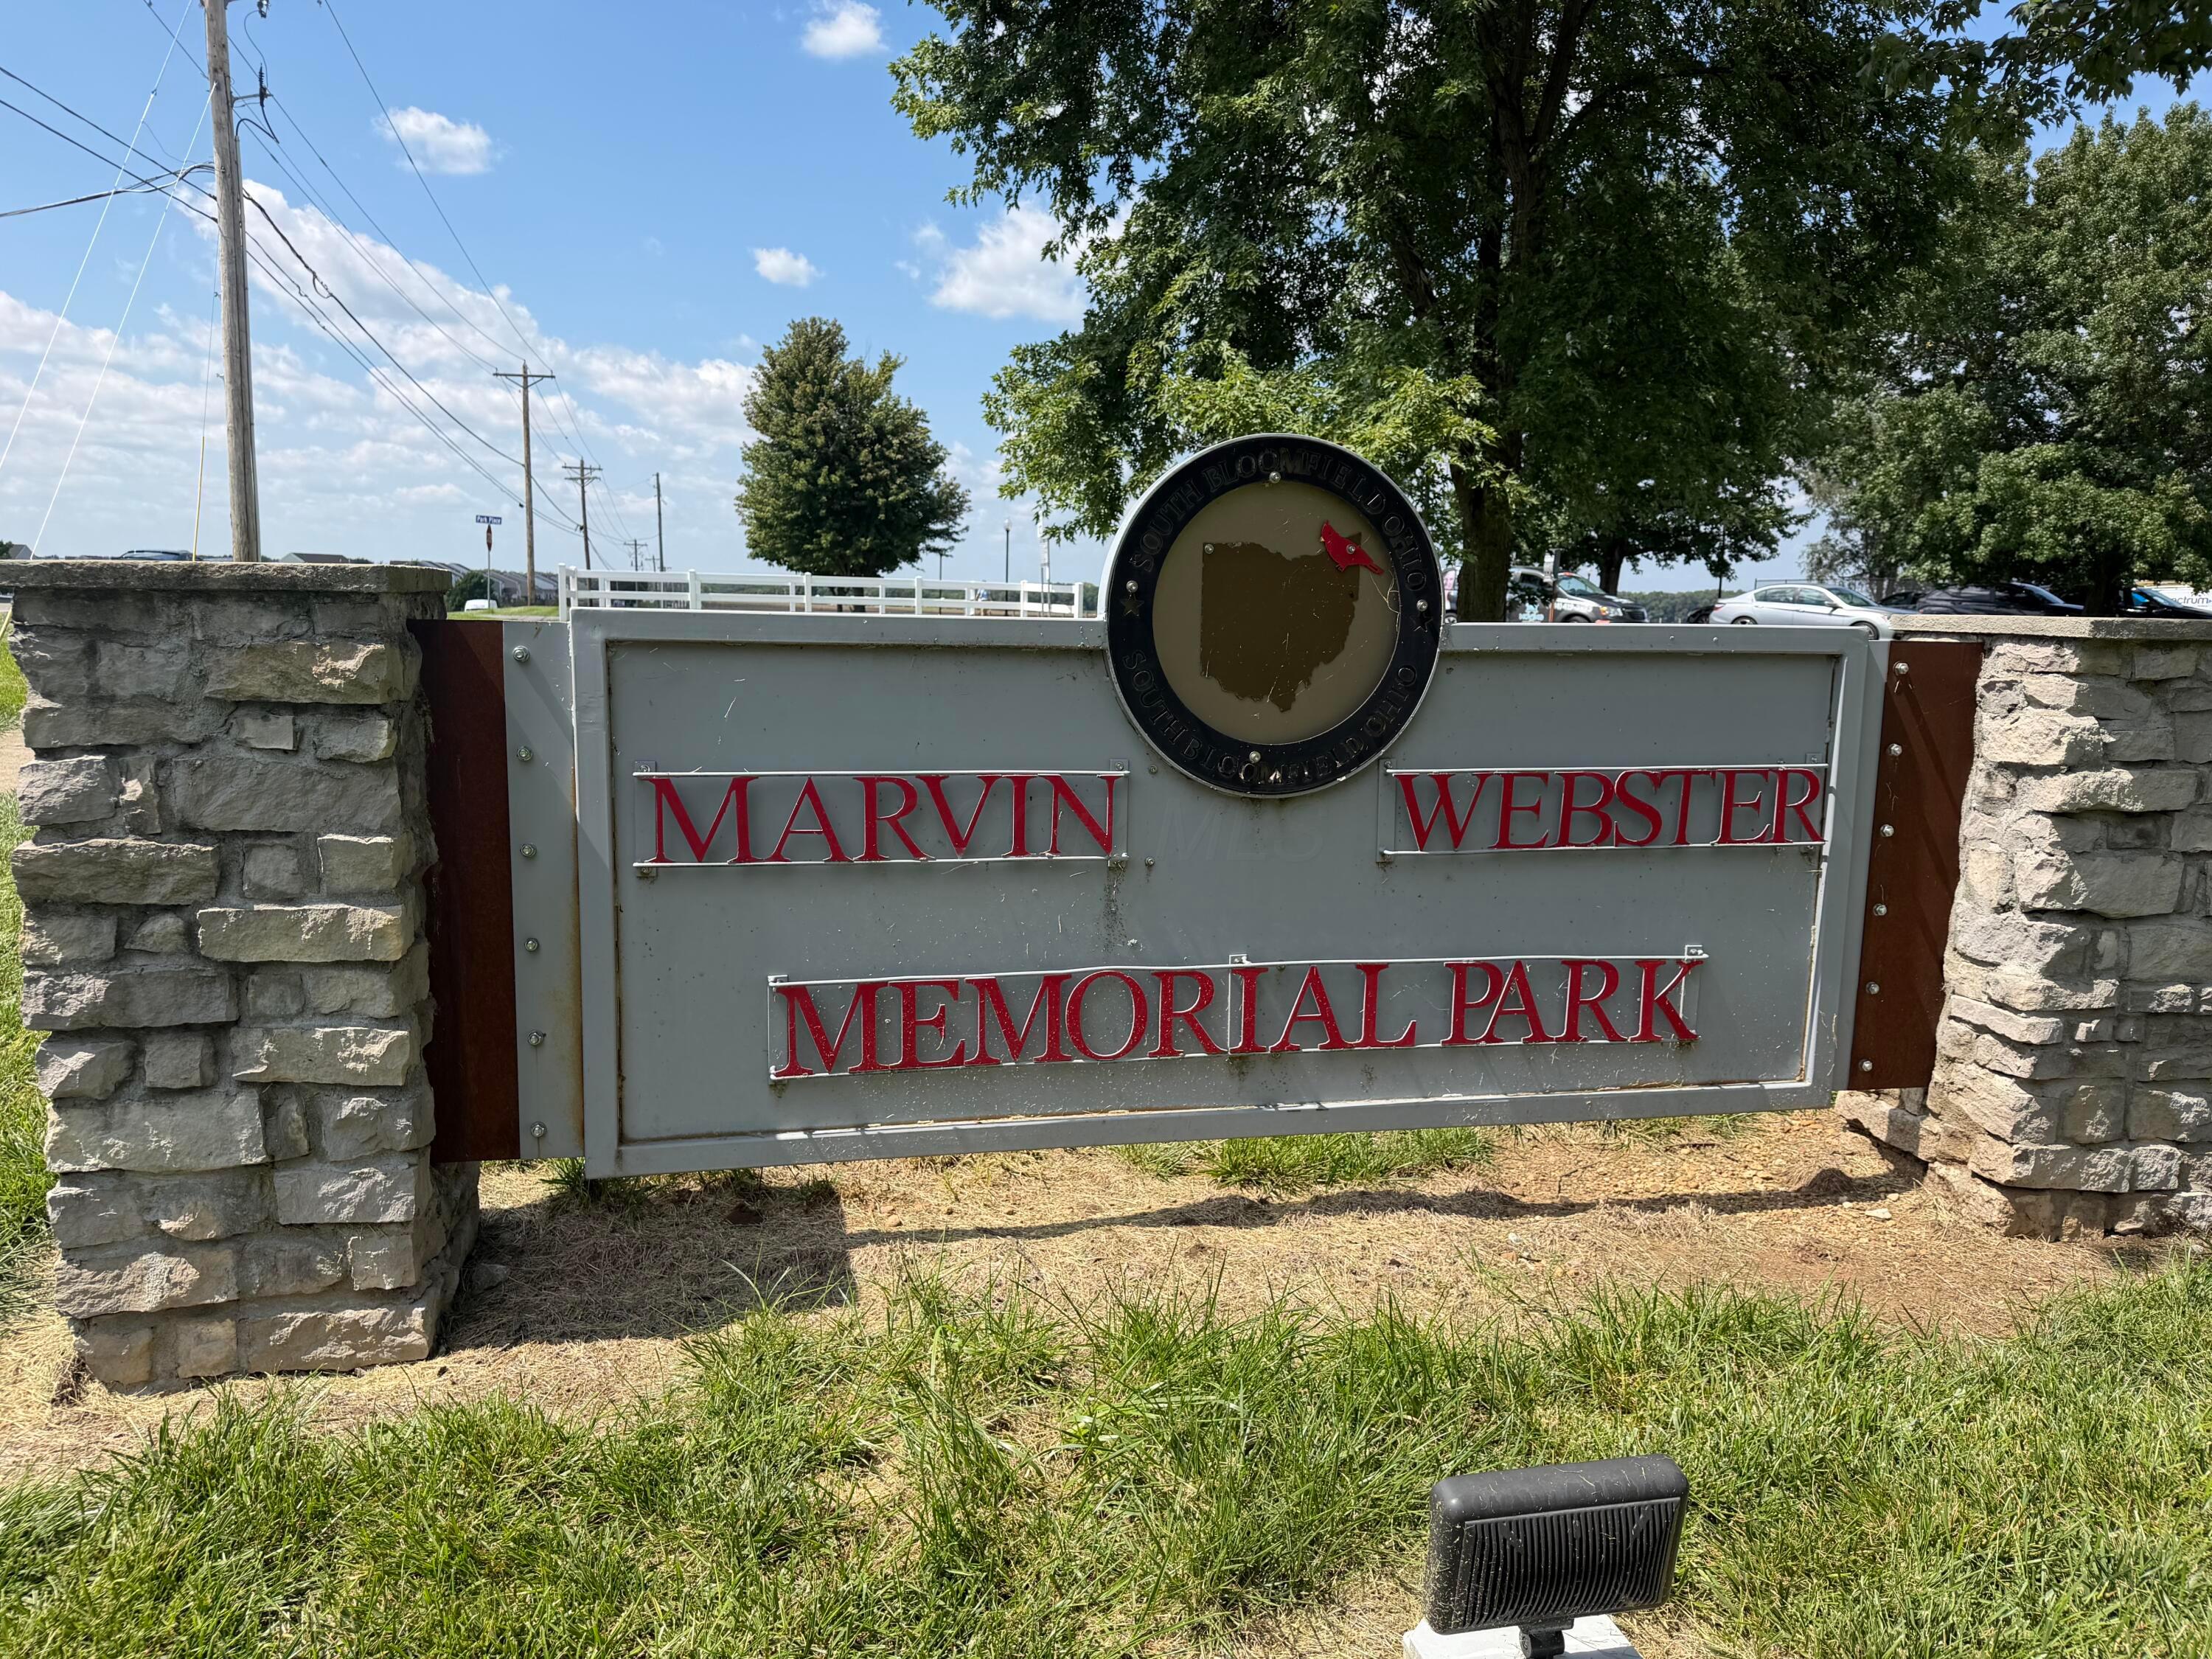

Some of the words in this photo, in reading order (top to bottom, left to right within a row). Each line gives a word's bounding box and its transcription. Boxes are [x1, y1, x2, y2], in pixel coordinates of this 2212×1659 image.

[1129, 482, 1204, 573] SOUTH
[1203, 447, 1388, 515] BLOOMFIELD
[1381, 515, 1427, 591] OHIO
[2171, 596, 2209, 605] ectrum
[1121, 649, 1186, 745] SOUTH
[1180, 737, 1366, 784] BLOOMFIELD
[1364, 664, 1418, 739] OHIO
[641, 774, 1118, 863] MARVIN
[1394, 768, 1826, 852] WEBSTER
[775, 963, 1417, 1077] MEMORIAL
[1440, 959, 1704, 1046] PARK
